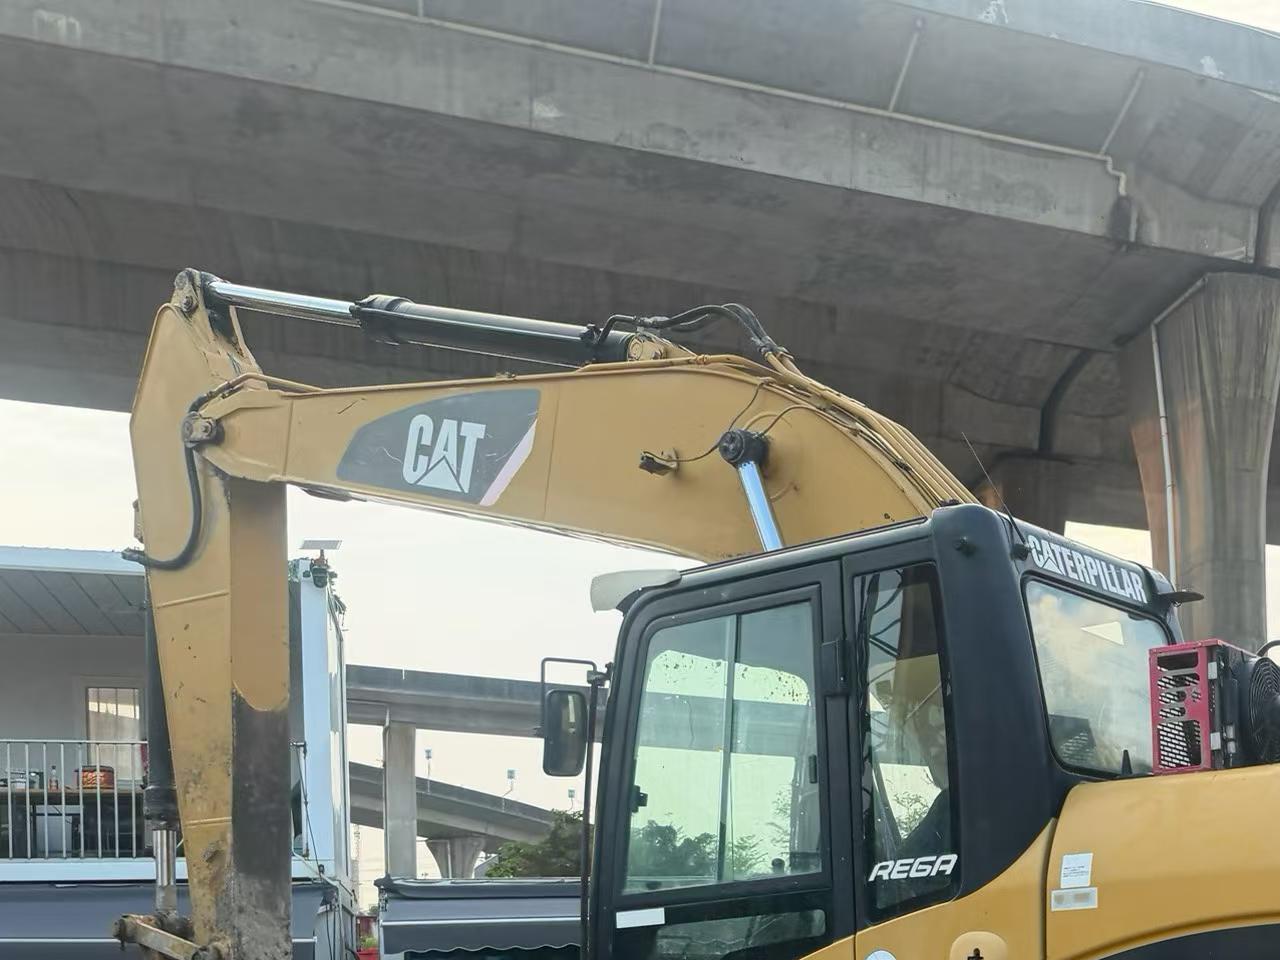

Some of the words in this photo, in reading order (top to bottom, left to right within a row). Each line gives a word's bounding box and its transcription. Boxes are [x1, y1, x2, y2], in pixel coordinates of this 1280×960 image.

[403, 414, 486, 493] CAT
[1027, 534, 1148, 604] CATERPILLAR
[868, 854, 958, 882] REGA
